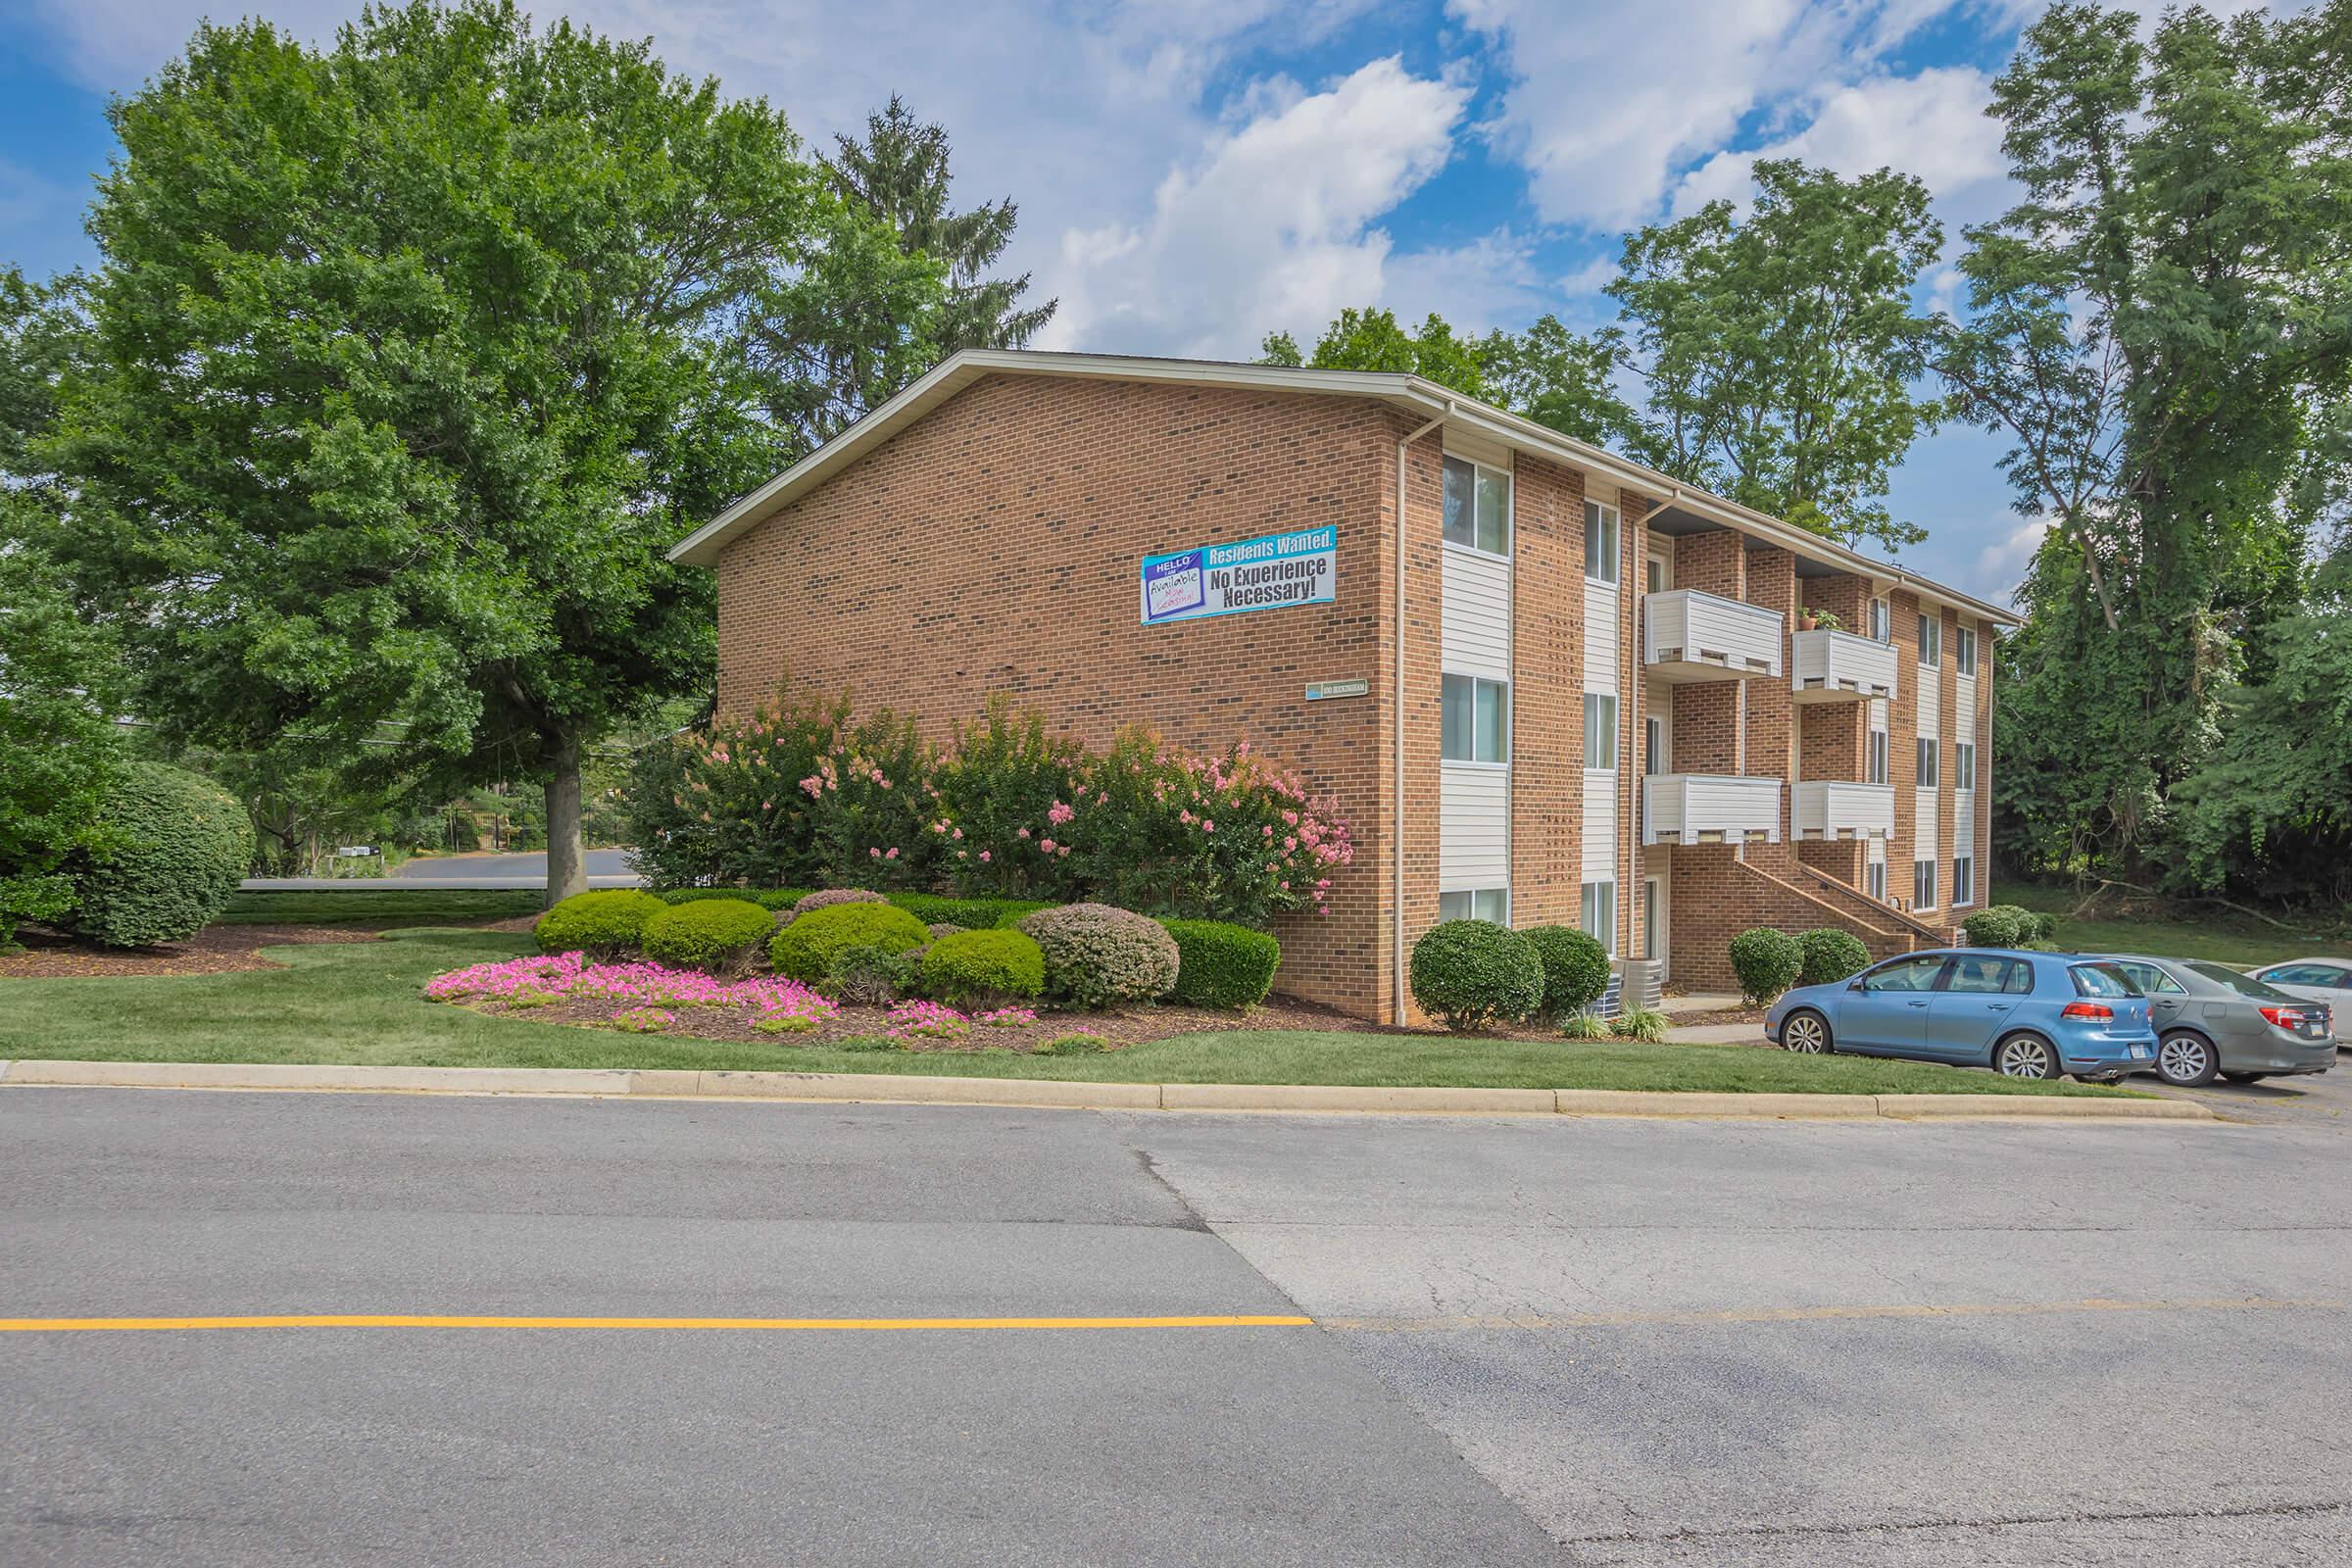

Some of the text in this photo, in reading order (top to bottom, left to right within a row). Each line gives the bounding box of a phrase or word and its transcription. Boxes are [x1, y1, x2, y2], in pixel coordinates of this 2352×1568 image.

[1208, 530, 1334, 565] Residents Wanted.
[1156, 556, 1191, 573] HELLO
[1210, 558, 1327, 590] No Experience
[1151, 570, 1198, 595] Available
[1223, 576, 1316, 609] Necessary!
